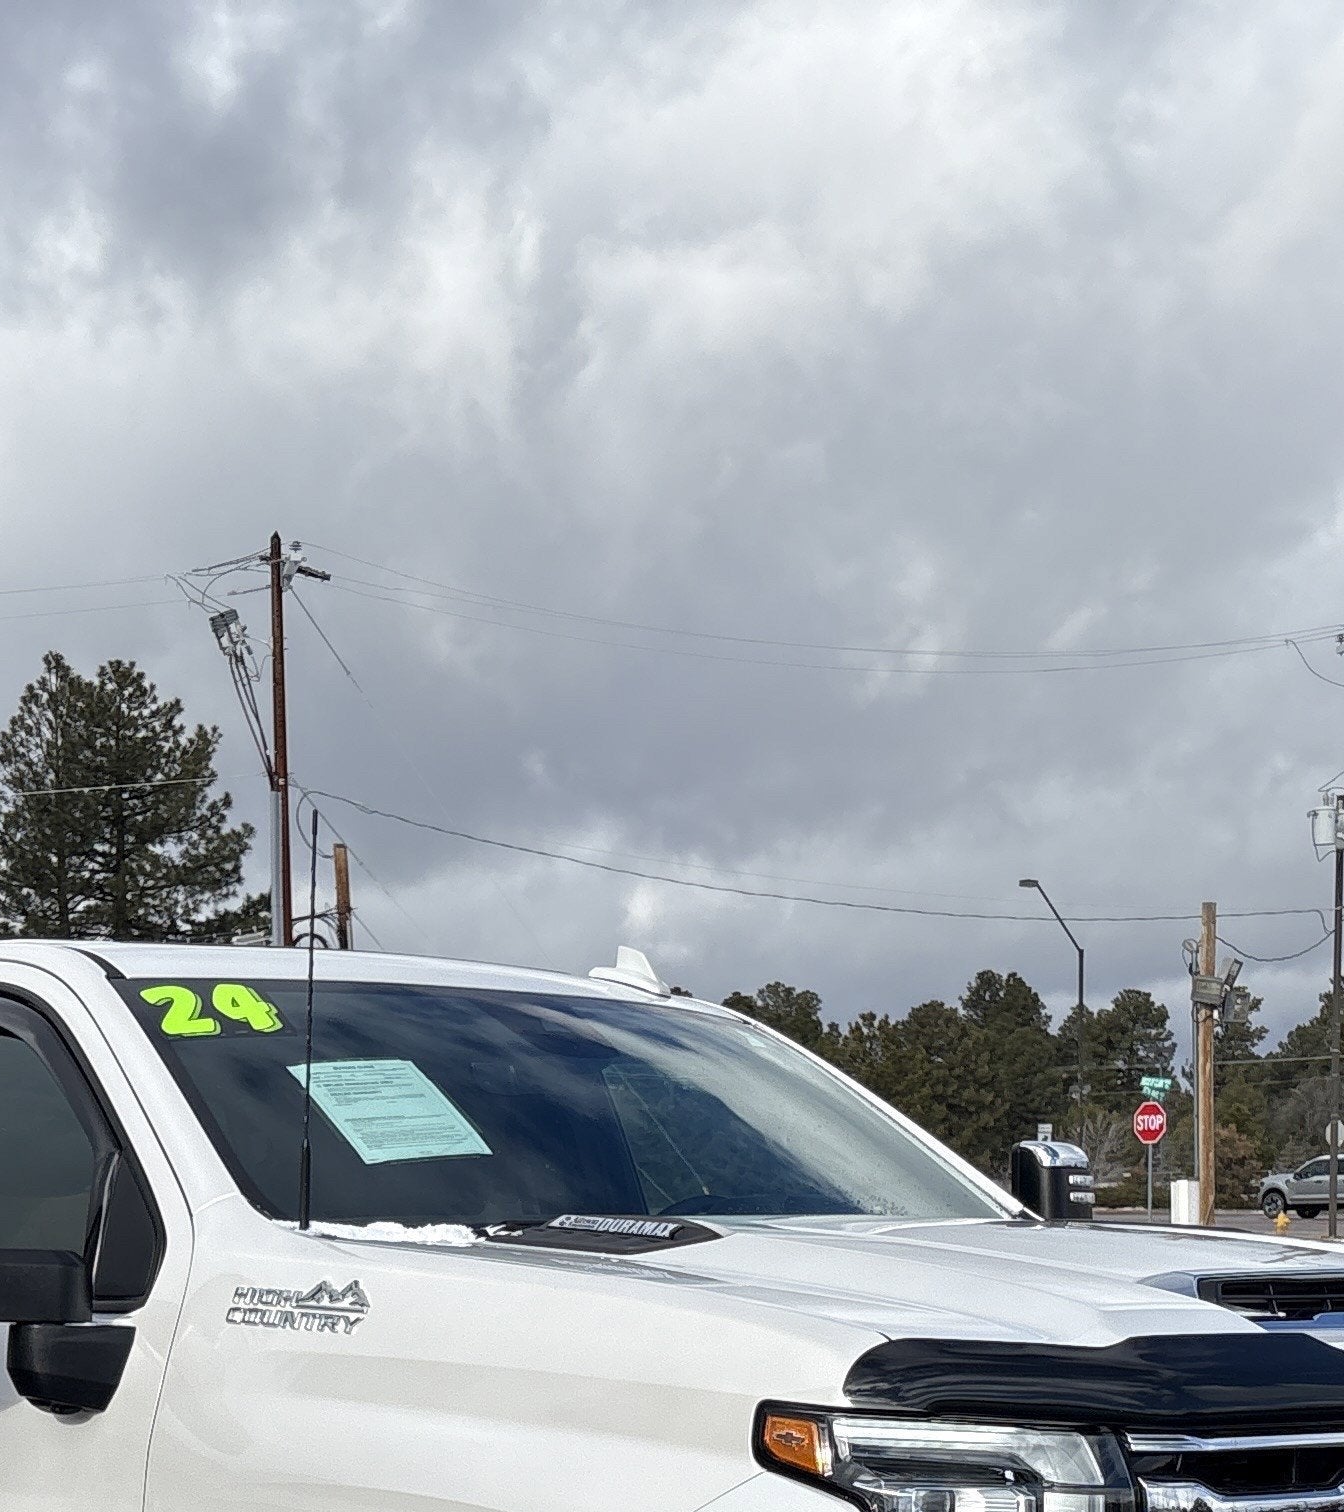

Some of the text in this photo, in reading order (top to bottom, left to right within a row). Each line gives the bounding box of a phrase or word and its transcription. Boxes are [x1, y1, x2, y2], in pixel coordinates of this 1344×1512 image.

[140, 984, 283, 1036] 24
[1137, 1115, 1163, 1131] STOP
[598, 1218, 677, 1238] DURAMAX
[232, 1287, 303, 1307] HIGH
[226, 1307, 365, 1334] COUNTRY
